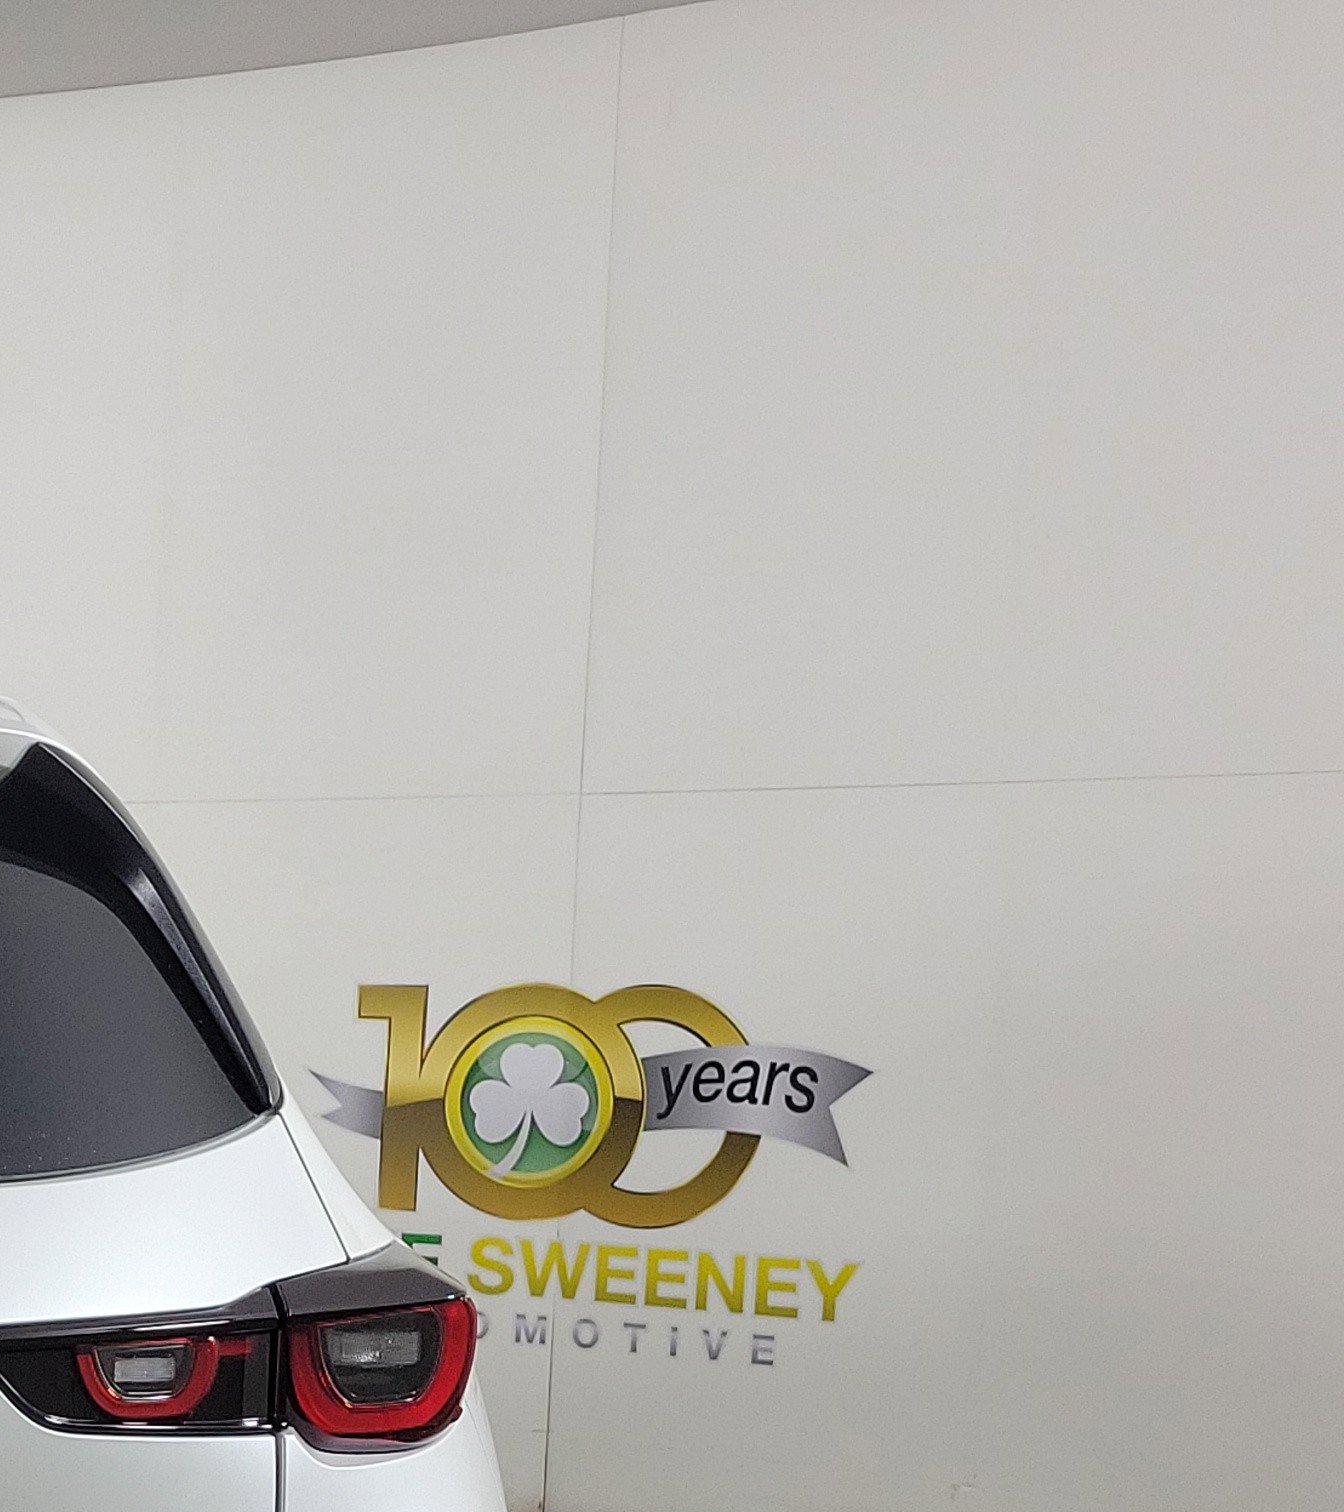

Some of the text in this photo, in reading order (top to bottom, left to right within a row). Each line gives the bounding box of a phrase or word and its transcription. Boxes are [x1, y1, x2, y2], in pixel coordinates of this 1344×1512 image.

[356, 982, 820, 1229] 100 years
[466, 1235, 860, 1323] SWEENEY
